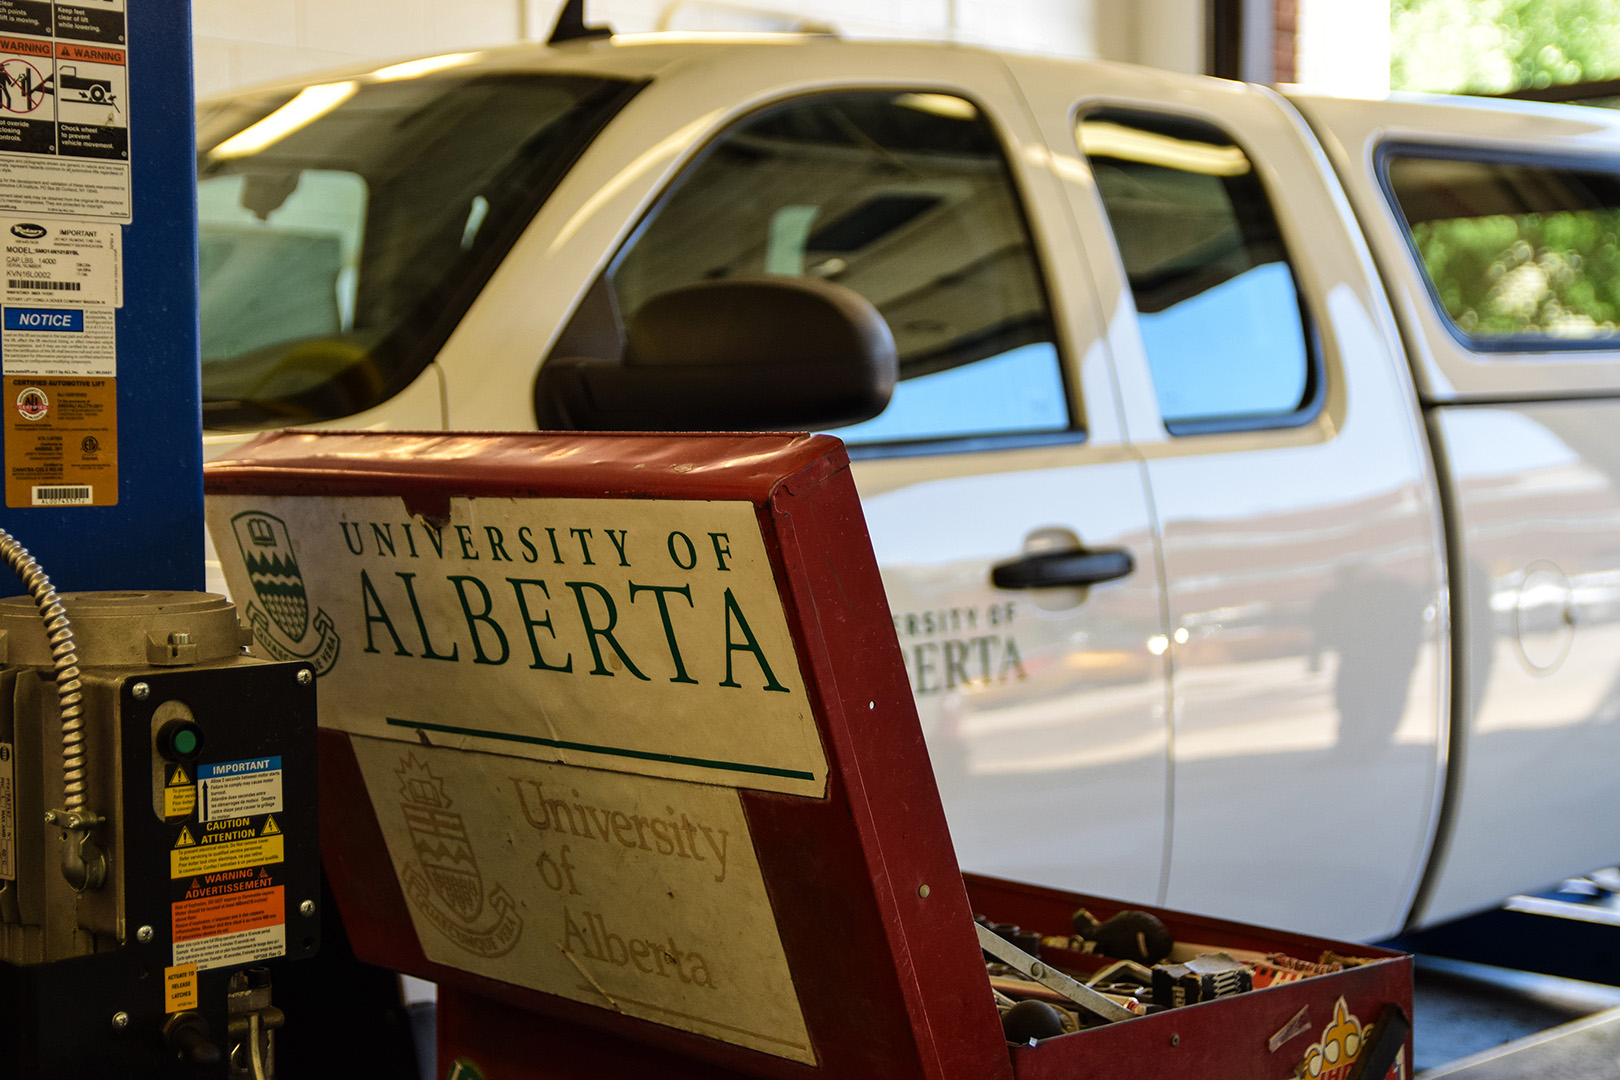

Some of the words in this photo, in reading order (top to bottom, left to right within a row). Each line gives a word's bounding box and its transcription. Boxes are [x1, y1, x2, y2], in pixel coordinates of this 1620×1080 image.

[0, 40, 50, 54] WARNING
[74, 48, 122, 62] WARNING
[19, 314, 72, 326] NOTICE
[339, 522, 632, 567] UNIVERSITY
[667, 531, 732, 572] OF
[360, 568, 791, 694] ALBERTA
[321, 636, 336, 662] VERA
[902, 634, 1029, 694] ERTA
[213, 760, 270, 775] IMPORTANT
[206, 817, 250, 832] CAUTION
[508, 776, 729, 883] University
[201, 828, 256, 844] ATTENTION
[204, 869, 253, 884] WARNING
[535, 844, 582, 896] of
[185, 877, 272, 899] ADVERTISSEMENT
[562, 905, 717, 990] Alberta
[168, 972, 187, 980] ACTUATE
[172, 981, 190, 989] RELEASE
[172, 991, 191, 999] LATCHES
